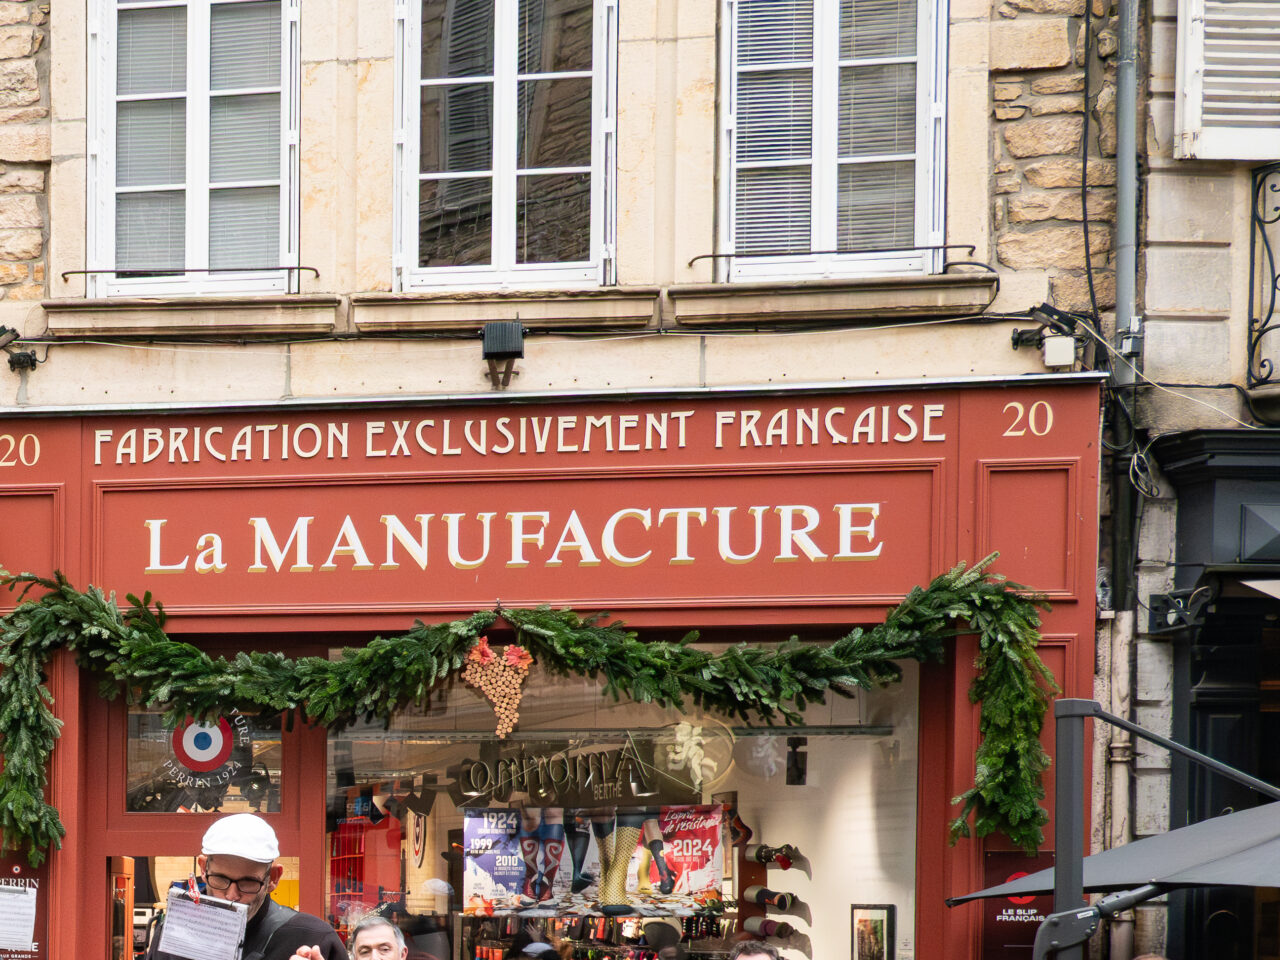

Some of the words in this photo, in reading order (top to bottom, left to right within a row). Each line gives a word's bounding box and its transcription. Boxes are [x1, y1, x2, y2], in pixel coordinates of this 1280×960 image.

[1003, 401, 1054, 437] 20
[94, 422, 350, 464] FABRICATION
[366, 410, 695, 458] EXCLUSIVEMENT
[714, 404, 947, 448] FRANÇAISE
[144, 519, 228, 575] La
[249, 502, 884, 573] MANUFACTURE
[163, 760, 212, 789] PERRIN
[216, 760, 243, 785] 1924
[482, 812, 517, 829] 1924
[470, 838, 493, 850] 1999
[673, 839, 713, 857] 2024
[495, 855, 518, 867] 2010
[996, 915, 1045, 923] FRANÇAIS
[1002, 908, 1015, 916] LE
